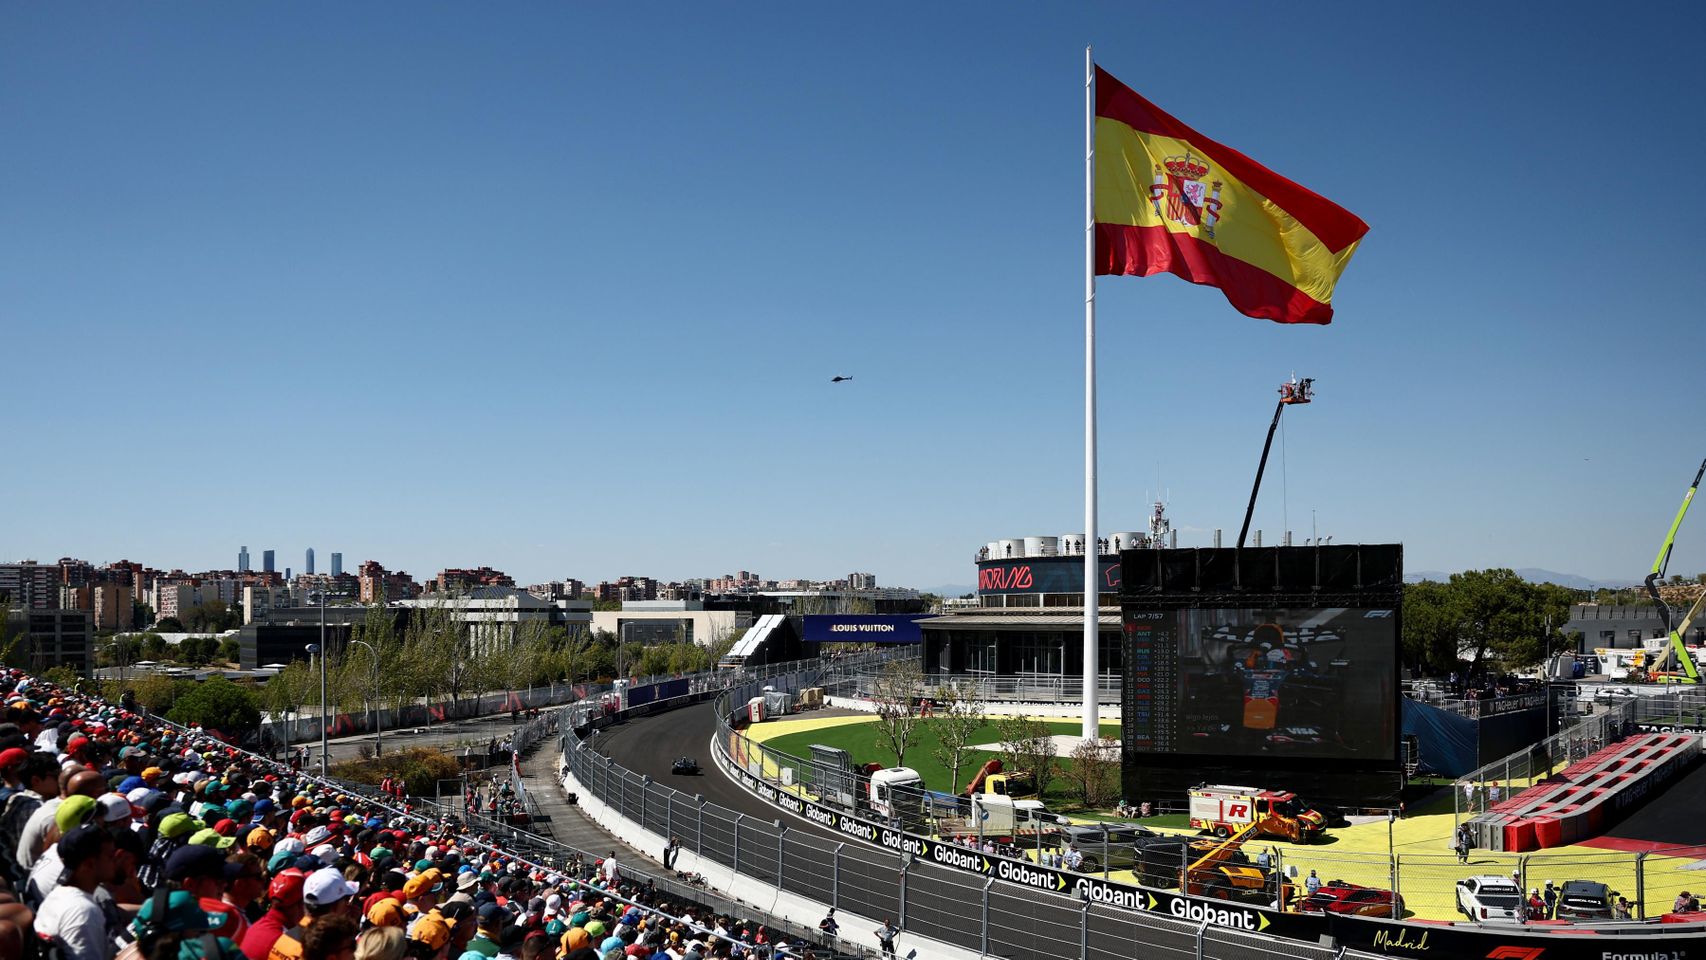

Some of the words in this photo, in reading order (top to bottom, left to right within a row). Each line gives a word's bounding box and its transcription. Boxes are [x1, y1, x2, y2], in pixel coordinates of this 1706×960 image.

[833, 624, 858, 632] LOUIS
[859, 624, 895, 632] VUITTON
[779, 792, 800, 813] Globant
[1229, 804, 1248, 818] R
[806, 804, 832, 825] Globant
[840, 816, 872, 839] Globant
[1240, 827, 1258, 842] JCB
[934, 845, 981, 872] Globant
[998, 861, 1056, 890] Globant
[1076, 878, 1145, 909] Globant
[208, 917, 220, 925] 14
[1170, 897, 1255, 930] Globant
[1373, 928, 1430, 951] Madrid
[1602, 952, 1668, 960] Formula
